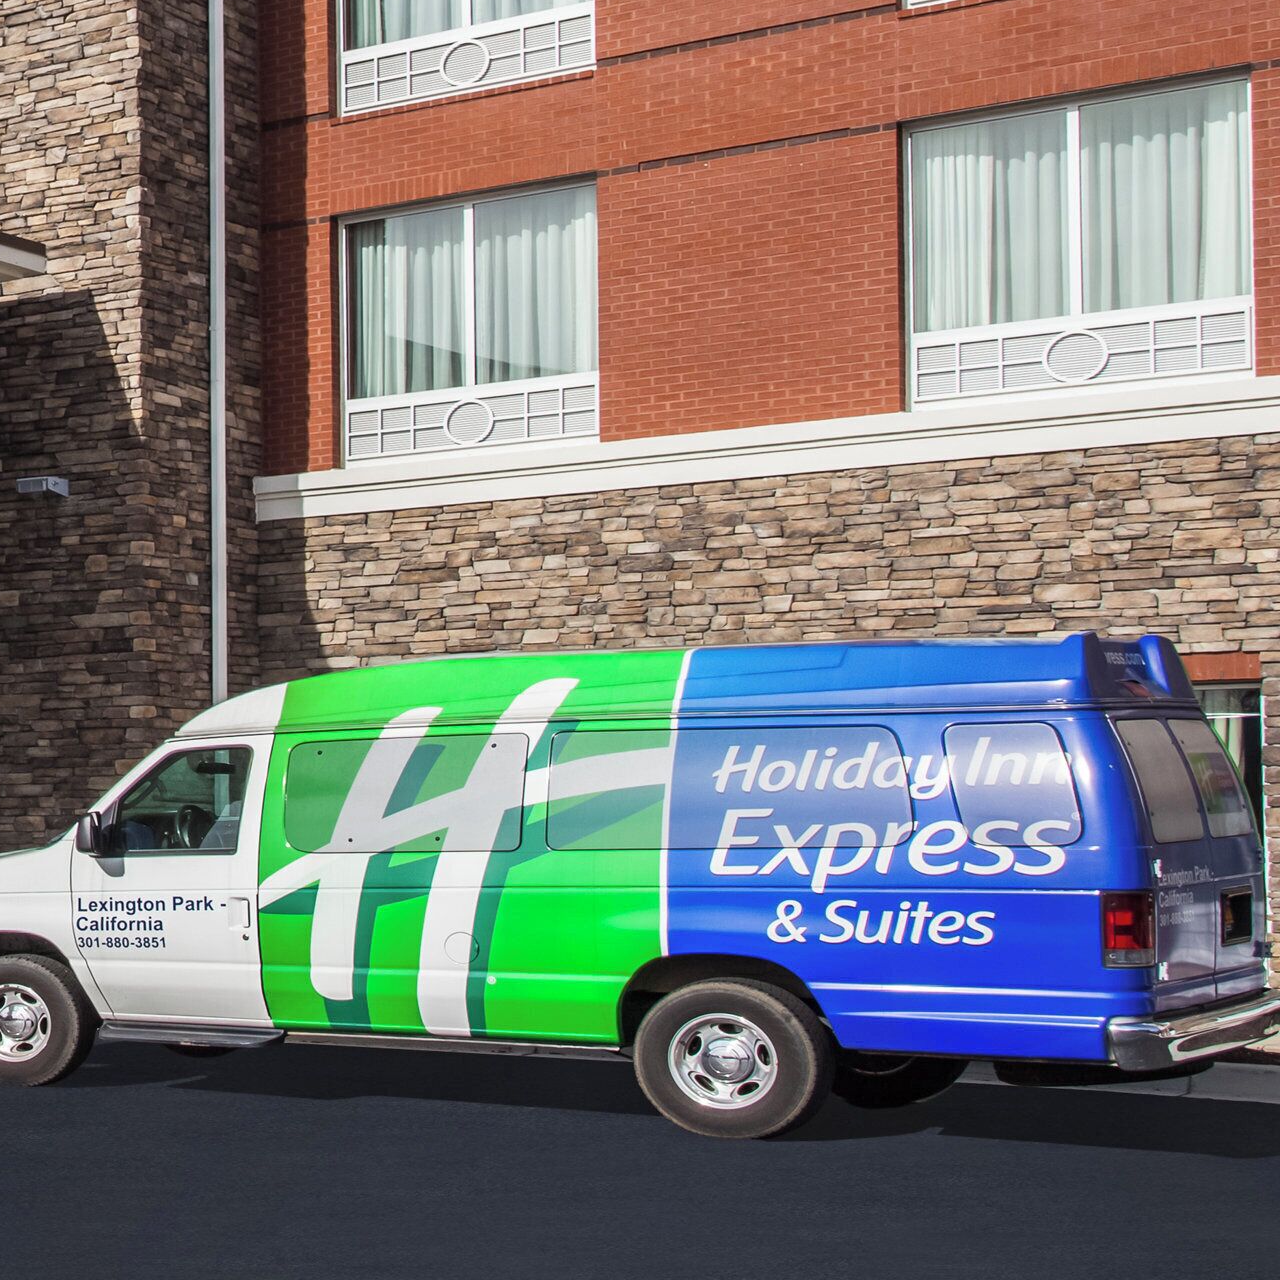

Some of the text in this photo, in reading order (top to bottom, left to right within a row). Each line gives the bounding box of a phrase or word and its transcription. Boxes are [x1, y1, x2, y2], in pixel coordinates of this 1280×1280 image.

[712, 737, 1073, 800] Holiday Inn
[709, 808, 1072, 893] Express
[77, 897, 166, 916] Lexington
[172, 895, 215, 912] Park
[1159, 888, 1194, 908] California
[76, 916, 164, 932] California
[766, 899, 996, 946] & Suites
[78, 936, 166, 949] 301-880-3851
